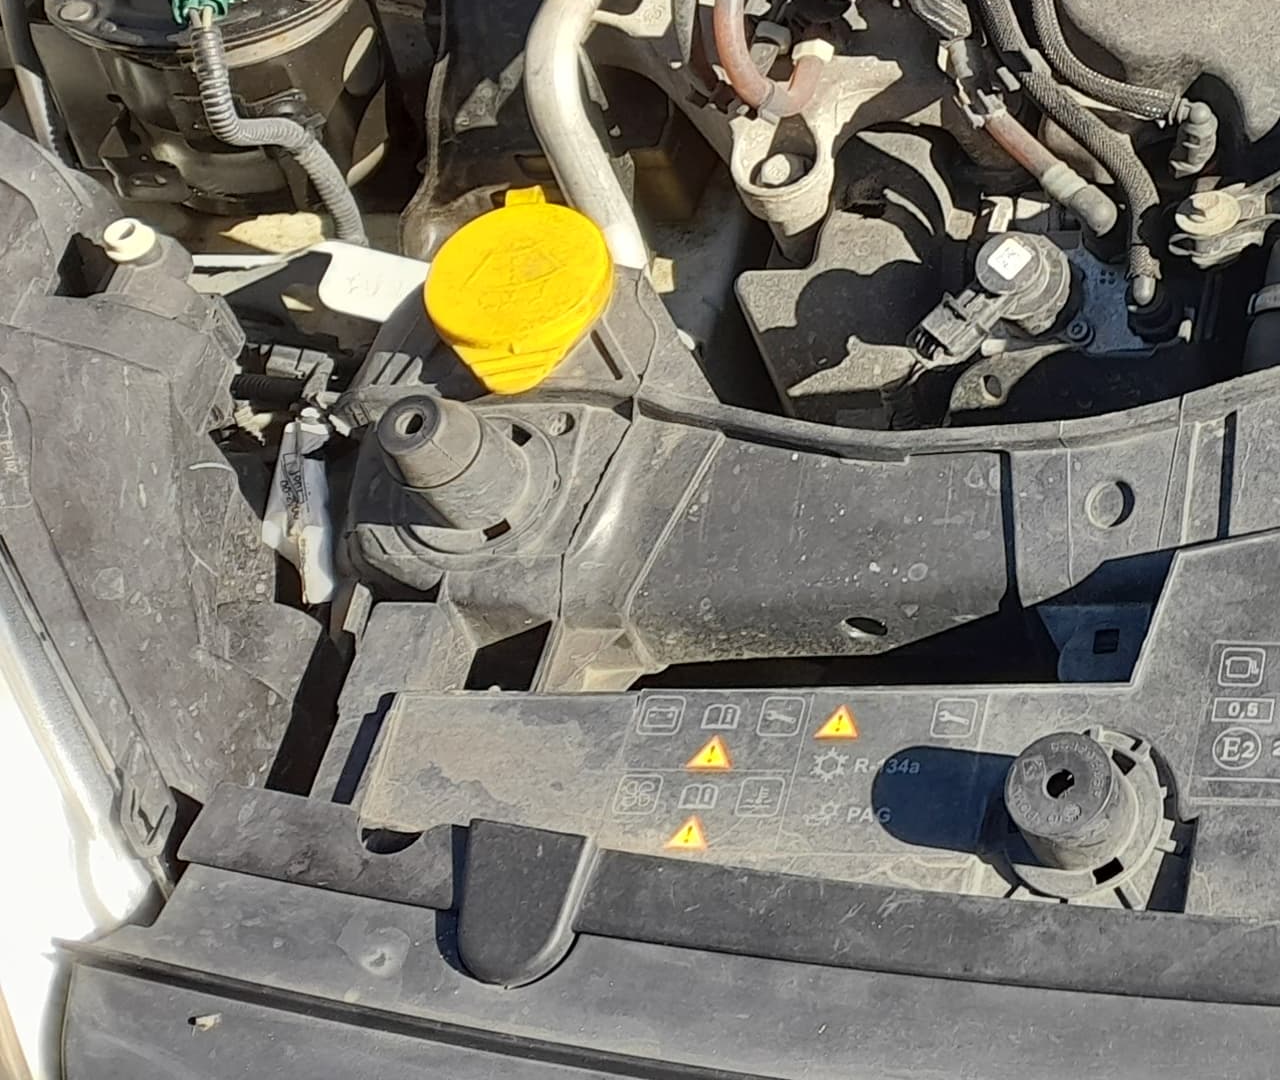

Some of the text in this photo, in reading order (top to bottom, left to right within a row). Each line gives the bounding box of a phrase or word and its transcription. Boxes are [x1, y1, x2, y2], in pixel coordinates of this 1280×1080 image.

[1228, 702, 1259, 719] 0,5
[1220, 737, 1256, 761] E2
[854, 758, 921, 774] R-134a
[846, 807, 892, 824] PAG
